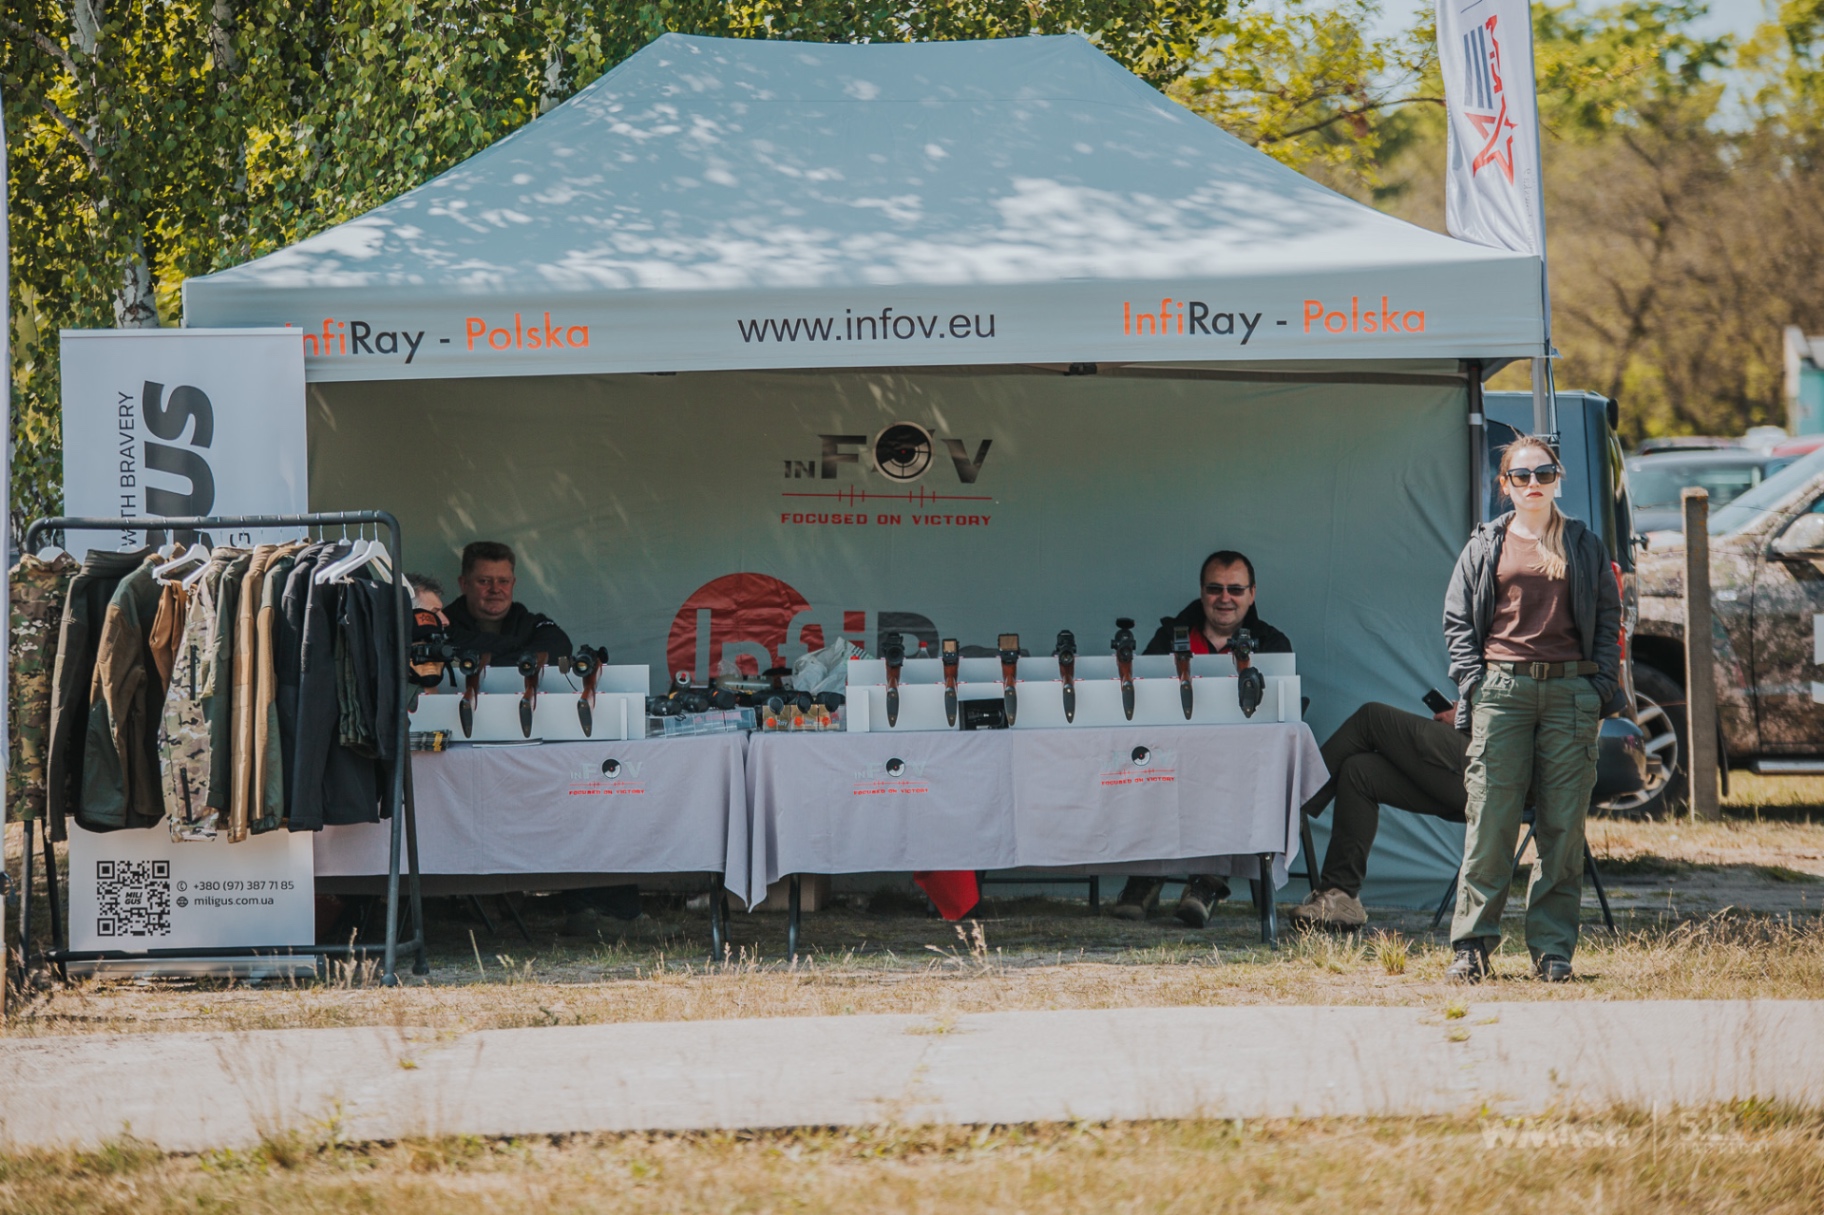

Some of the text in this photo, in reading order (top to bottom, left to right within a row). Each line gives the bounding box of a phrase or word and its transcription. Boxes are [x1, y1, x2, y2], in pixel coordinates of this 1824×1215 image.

[737, 307, 996, 343] www.infov.eu
[1123, 295, 1426, 346] InfiRay - Polska
[285, 311, 590, 364] nfiRay - Polska
[118, 391, 137, 547] WTH BRAVERY
[142, 380, 216, 549] US
[780, 512, 992, 527] FOCUSED ON VICTORY
[125, 891, 143, 899] MILI
[194, 880, 295, 892] +380 (97) 387 71 85
[124, 898, 142, 906] GUS
[194, 895, 275, 908] miligus.com.ua
